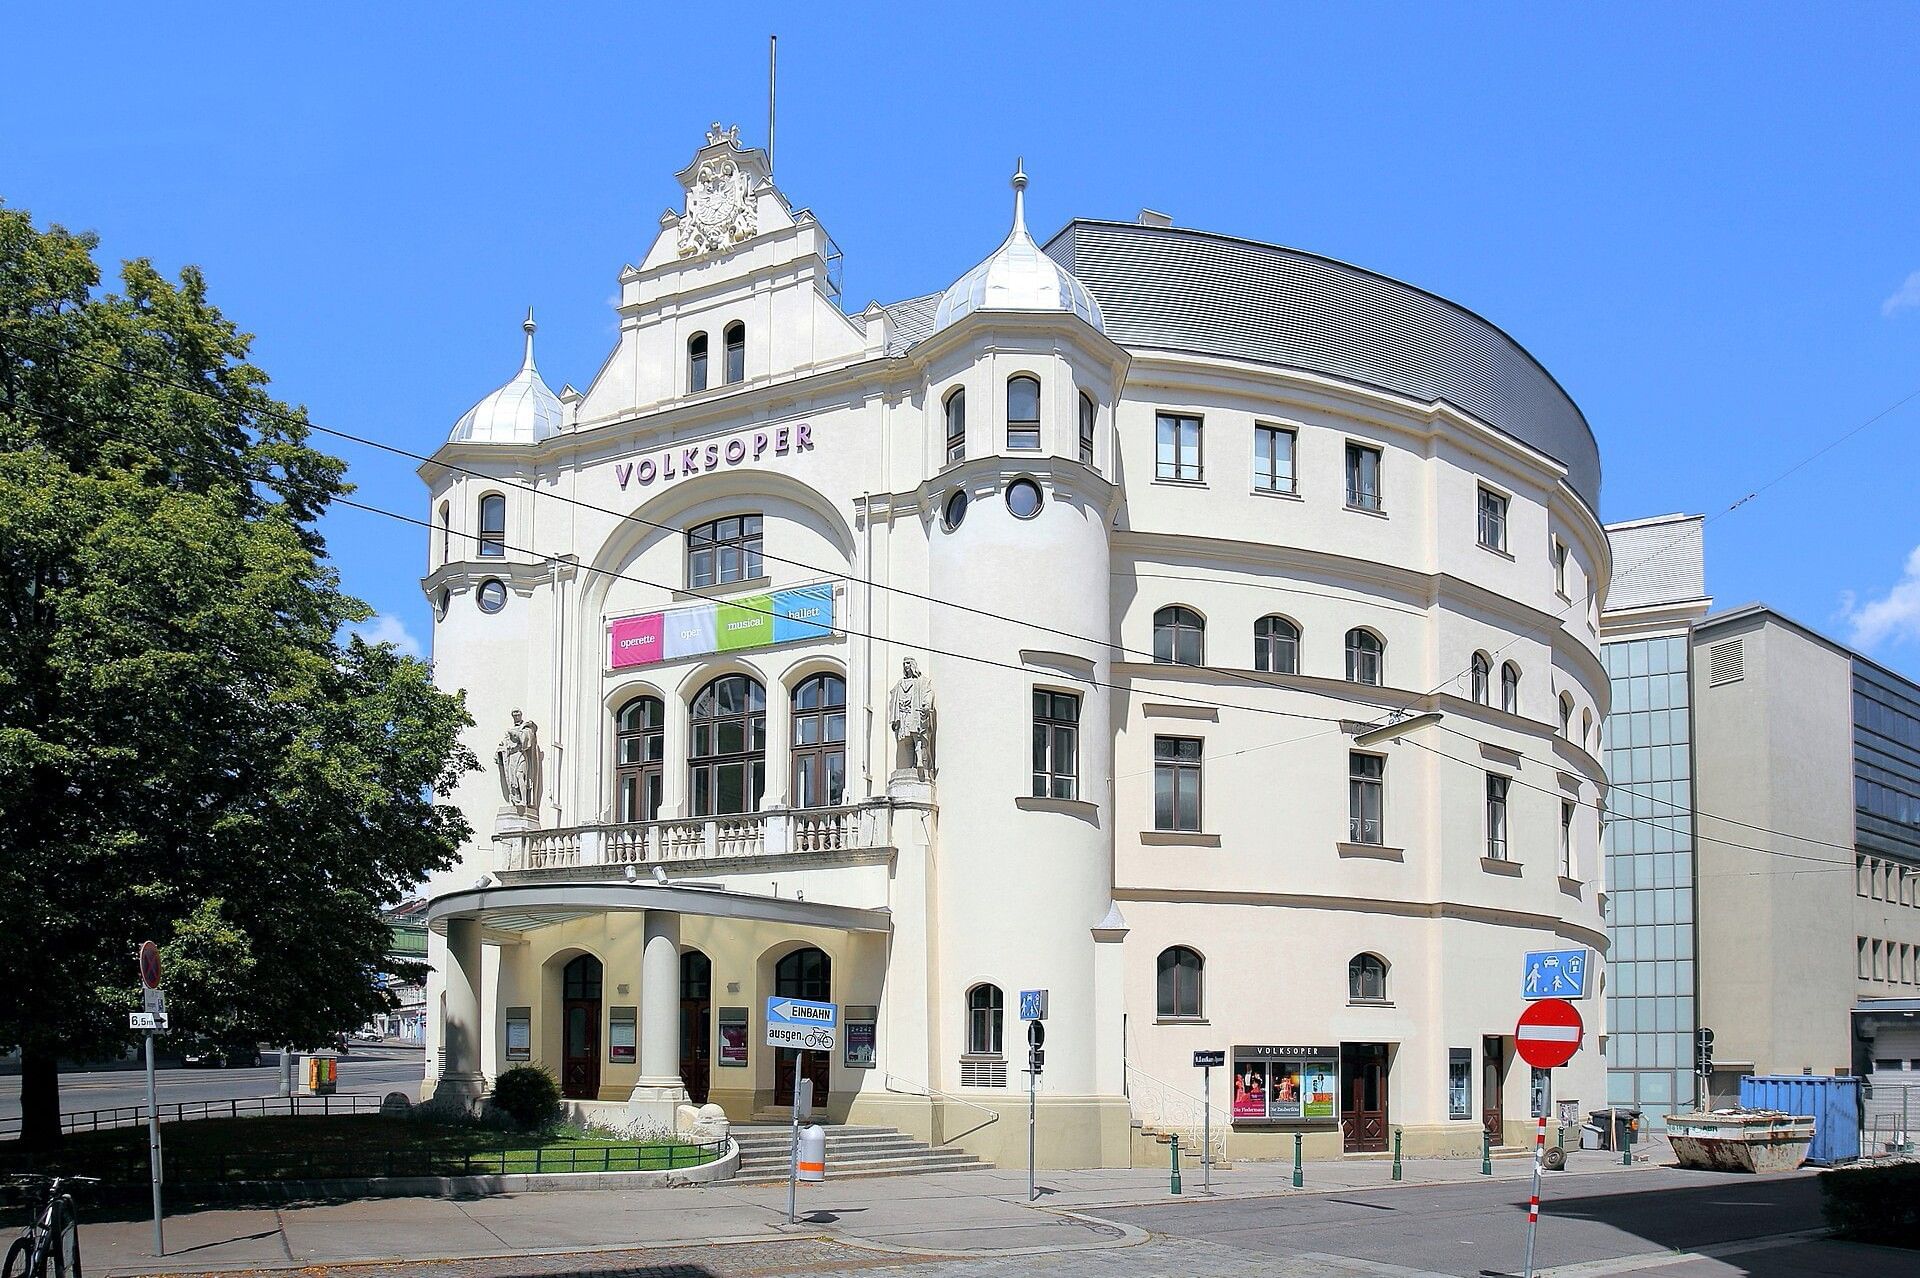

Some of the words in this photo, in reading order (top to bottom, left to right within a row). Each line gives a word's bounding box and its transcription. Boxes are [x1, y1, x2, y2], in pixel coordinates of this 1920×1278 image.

[615, 423, 814, 489] VOLKSOPER
[620, 634, 655, 648] operette
[680, 627, 702, 639] oper
[727, 616, 764, 631] musical
[788, 607, 820, 619] ballett
[792, 1006, 831, 1019] EINBAHN
[769, 1029, 804, 1042] ausgen.
[1257, 1047, 1318, 1055] VOLKSOPER
